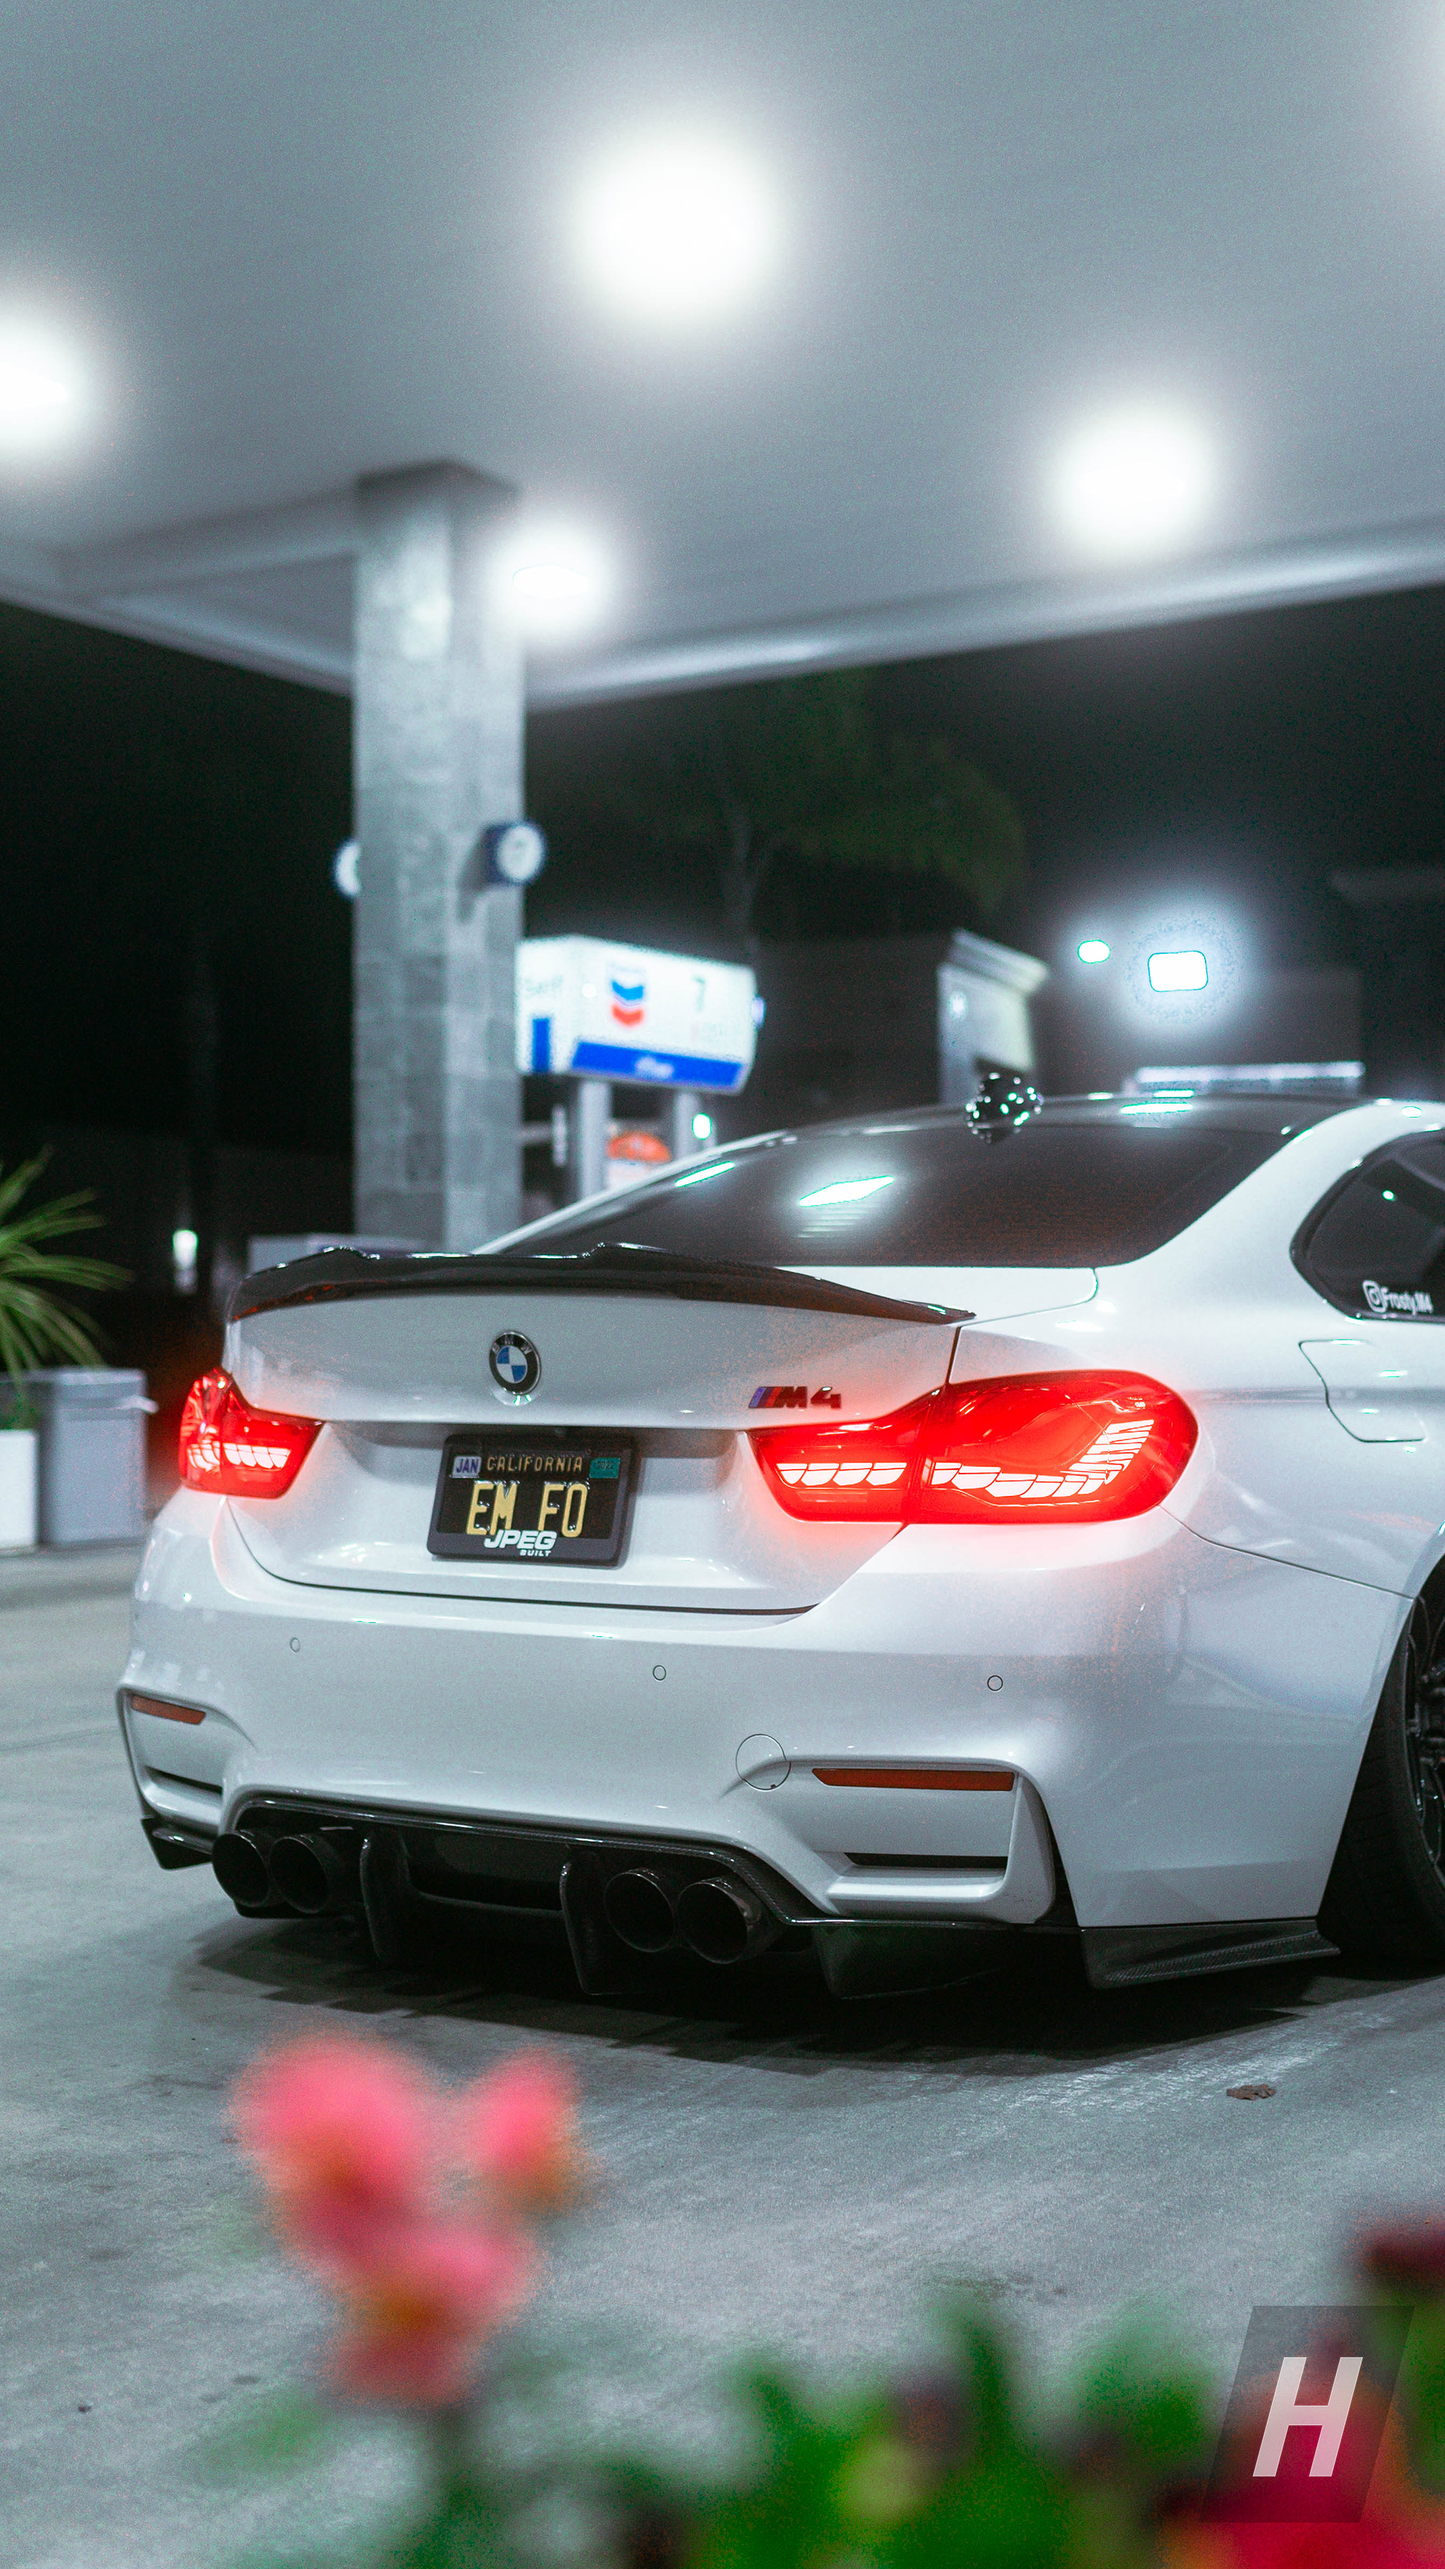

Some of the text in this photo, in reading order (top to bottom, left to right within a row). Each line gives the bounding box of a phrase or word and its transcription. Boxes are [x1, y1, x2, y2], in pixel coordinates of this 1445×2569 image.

[491, 1333, 533, 1355] BMW
[749, 1386, 841, 1409] M4
[456, 1459, 479, 1474] JAN
[487, 1456, 583, 1472] CALIFORNIA
[483, 1529, 557, 1550] JPEG
[519, 1549, 551, 1557] BUILT
